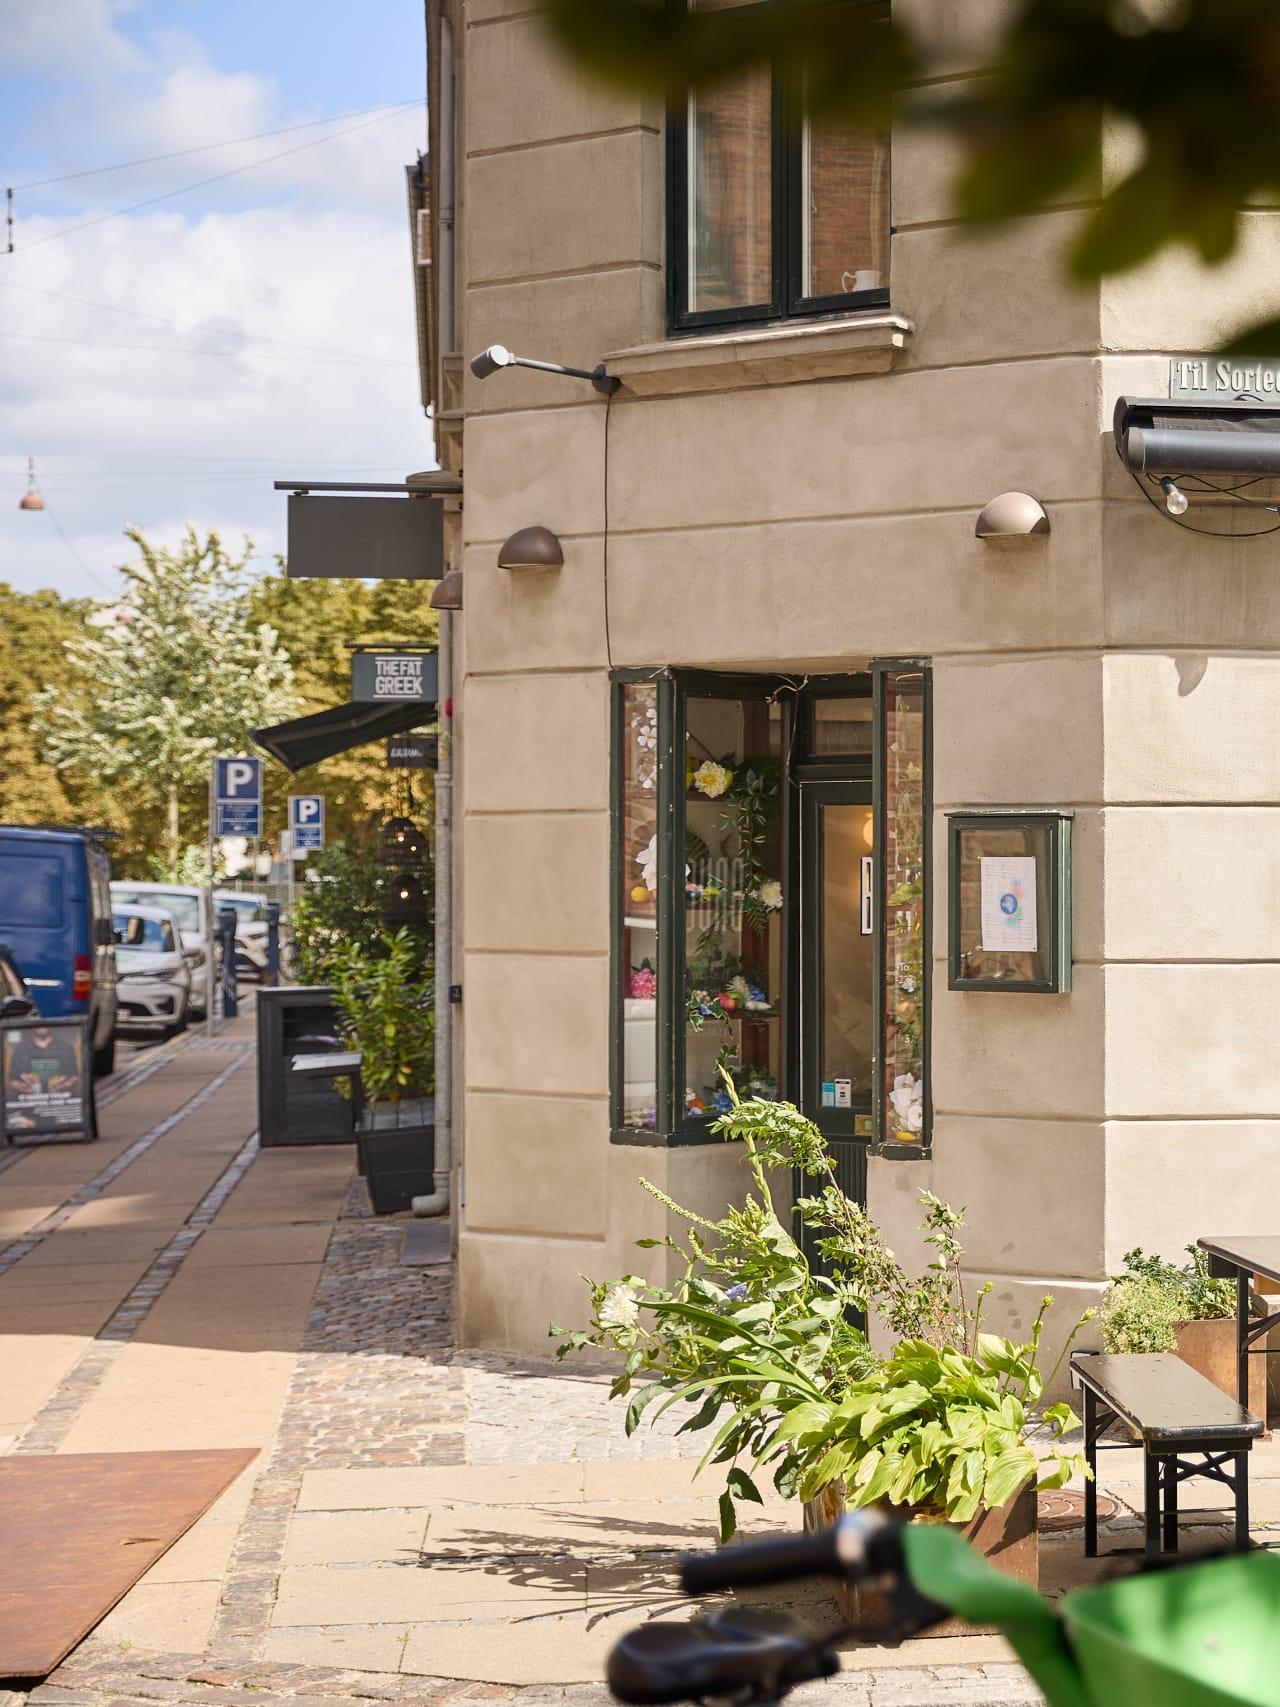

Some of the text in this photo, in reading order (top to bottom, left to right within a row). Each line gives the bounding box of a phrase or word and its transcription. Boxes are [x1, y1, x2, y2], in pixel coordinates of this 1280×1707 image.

[1177, 361, 1207, 390] Til
[375, 661, 422, 676] THE FAT
[375, 676, 423, 694] GREEK
[226, 762, 253, 797] P
[299, 800, 318, 823] P
